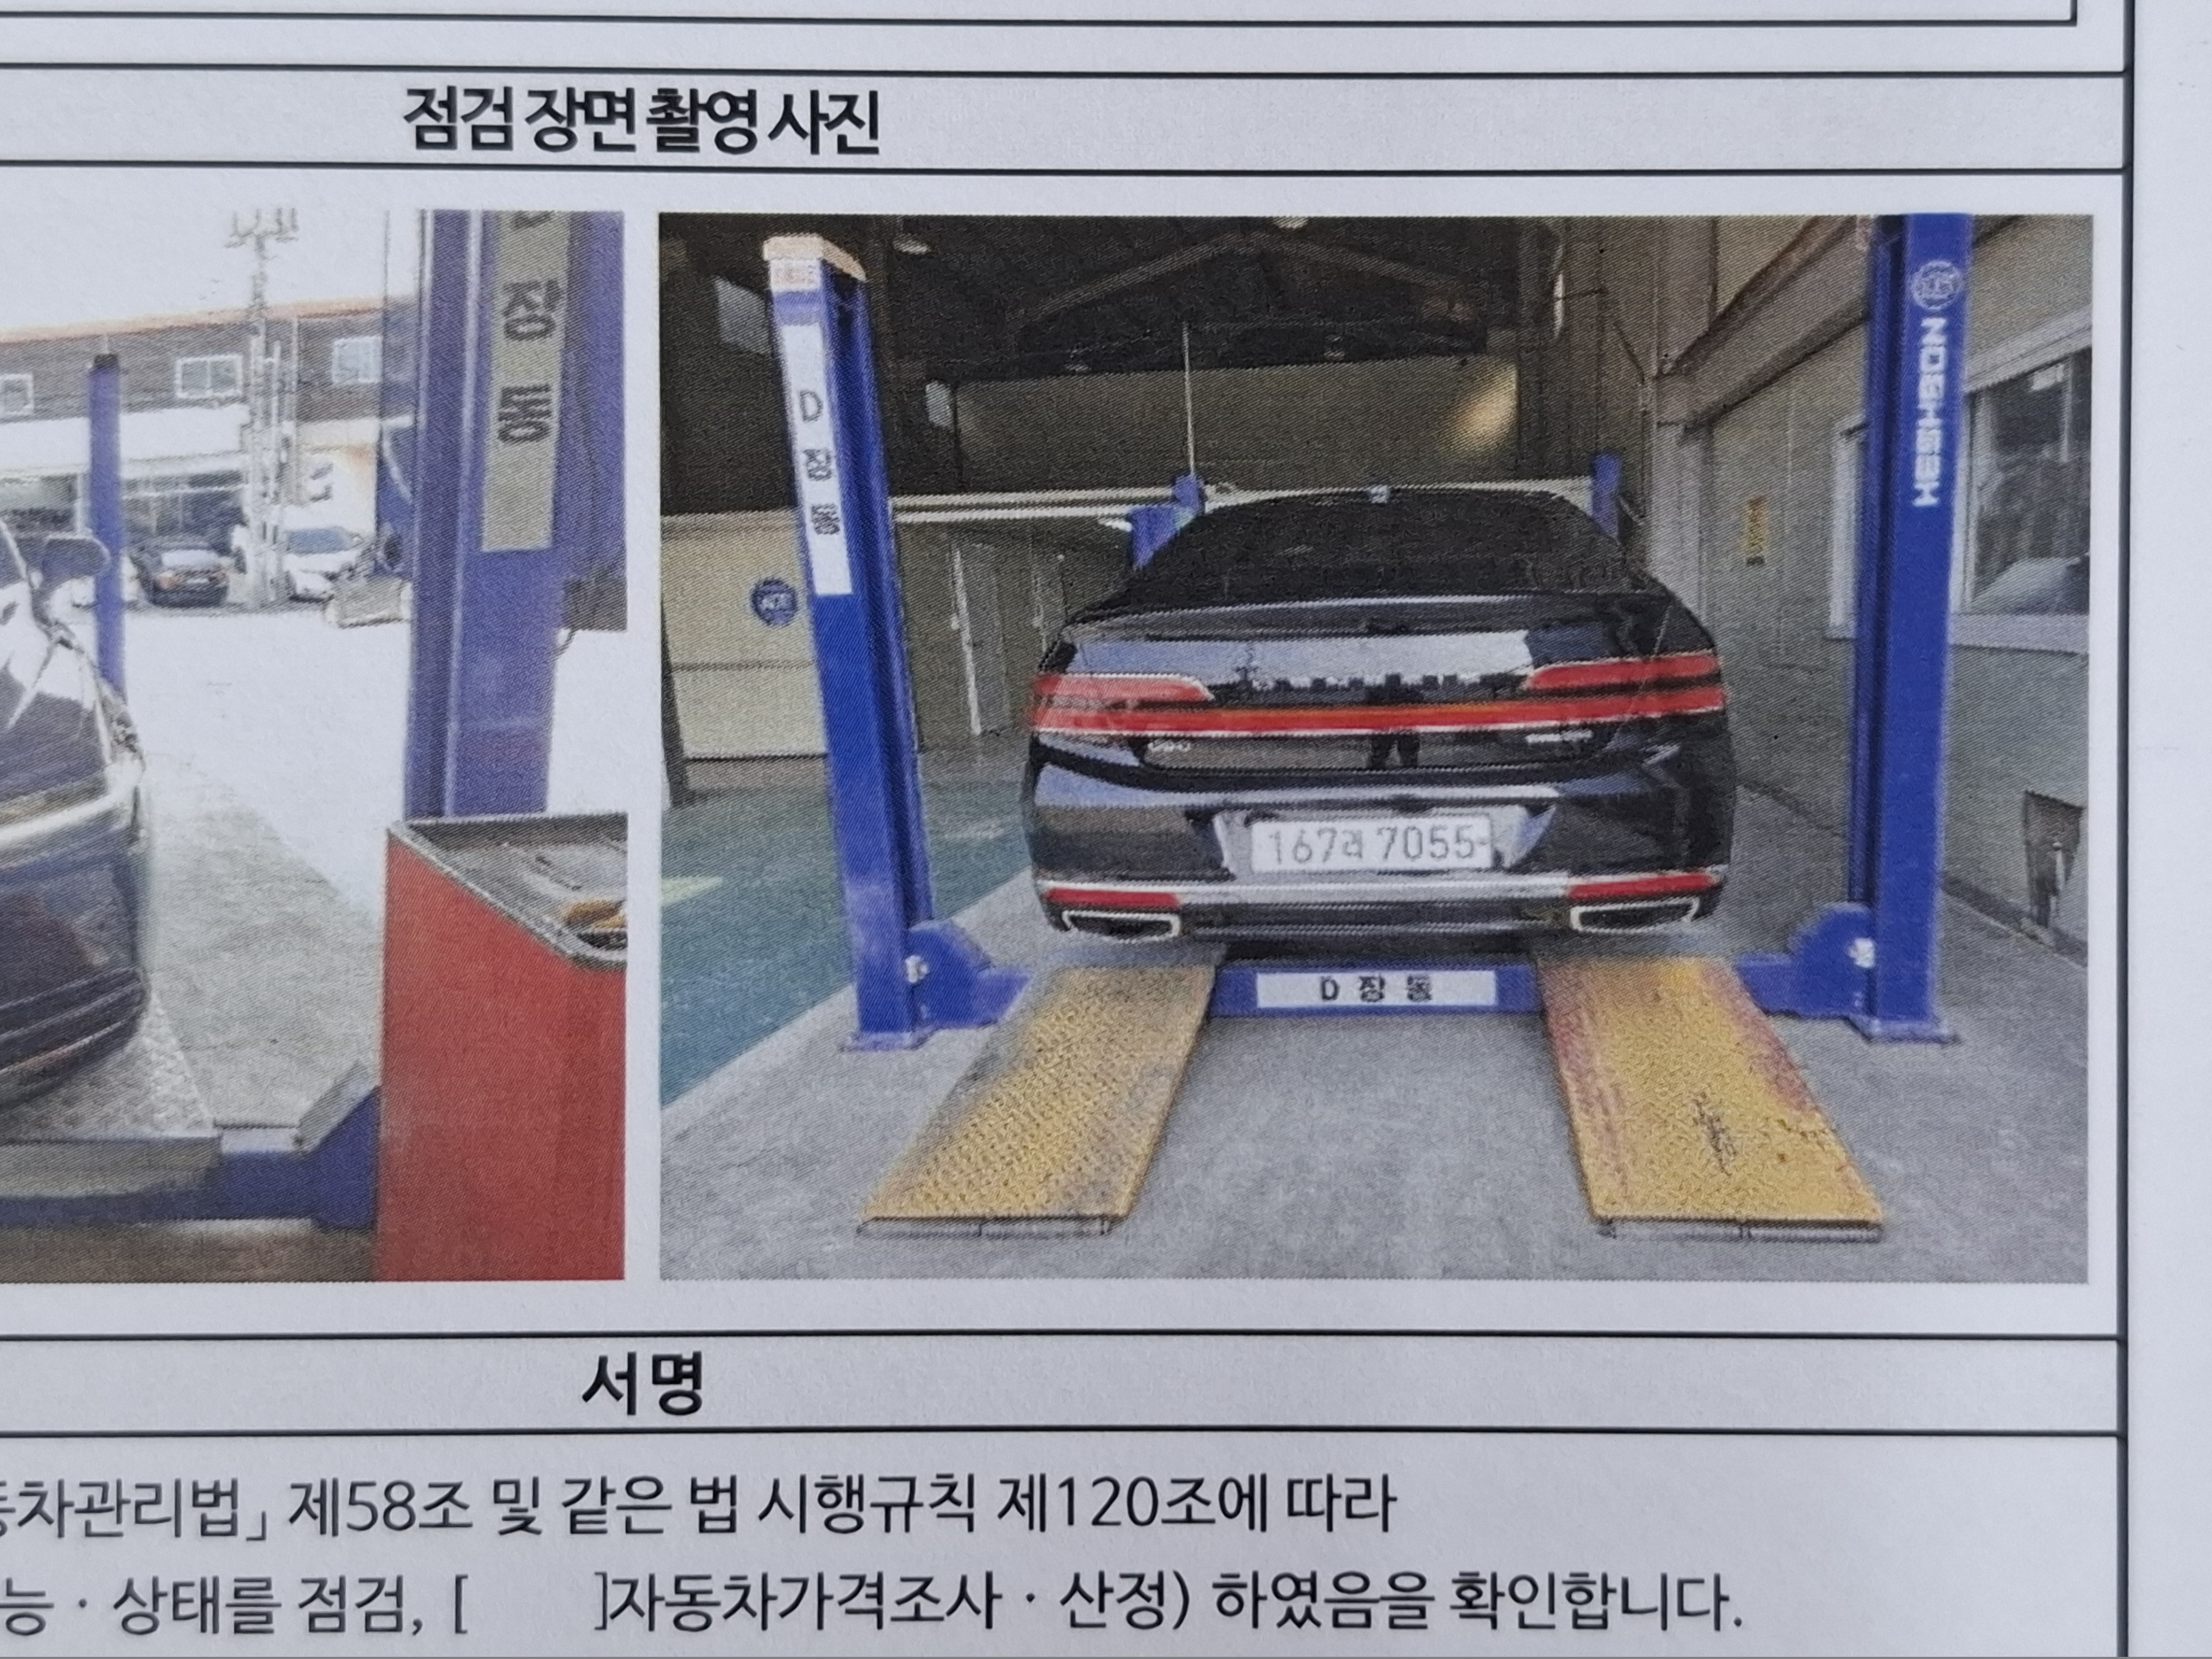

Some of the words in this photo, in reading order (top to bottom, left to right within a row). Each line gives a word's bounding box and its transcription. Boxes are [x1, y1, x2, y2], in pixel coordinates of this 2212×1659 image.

[403, 86, 512, 150] 점검
[525, 87, 635, 152] 장면
[646, 88, 757, 155] 촬영
[768, 90, 879, 155] 사진
[1376, 824, 1475, 861] 7055
[289, 1478, 472, 1537] 제58조
[493, 1477, 541, 1535] 및
[562, 1476, 672, 1534] 같은
[691, 1475, 736, 1533] 법
[758, 1474, 974, 1534] 시행규칙
[998, 1473, 1266, 1533] 제120조에
[1288, 1474, 1397, 1533] 따라
[113, 1577, 281, 1635] 상태를
[299, 1576, 422, 1635] 점검,
[1060, 1571, 1189, 1630] 산정)
[1212, 1571, 1435, 1630] 하였음을
[1450, 1572, 1741, 1631] 확인합니다.
